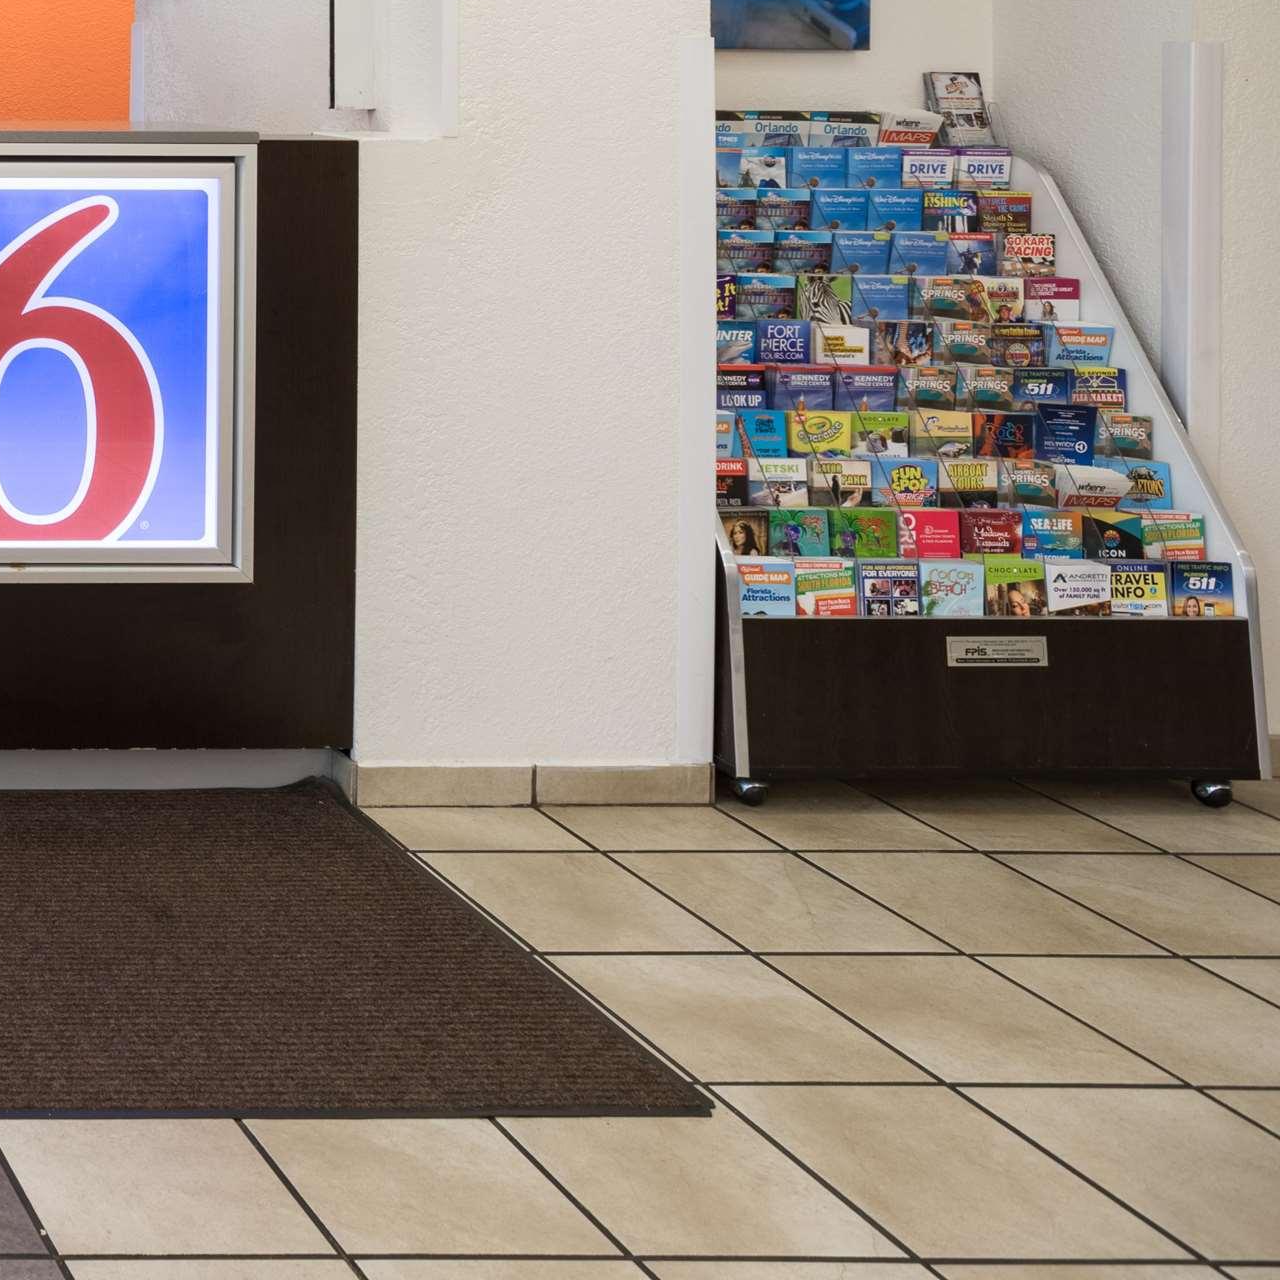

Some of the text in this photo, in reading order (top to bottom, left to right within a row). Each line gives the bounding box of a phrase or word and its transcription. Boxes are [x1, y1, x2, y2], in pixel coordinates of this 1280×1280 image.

[754, 122, 799, 134] Orlando
[823, 124, 867, 135] Orlando
[890, 132, 931, 143] MAPS
[910, 163, 947, 174] DRIVE
[968, 163, 1004, 174] DRIVE
[924, 196, 968, 208] FISHING
[1007, 236, 1052, 246] GO KART
[1006, 246, 1052, 257] RACING
[921, 289, 966, 301] SPRINGS
[767, 325, 800, 338] FORT
[761, 339, 804, 352] PIERCE
[940, 334, 986, 346] SPRINGS
[1086, 336, 1106, 344] MAP
[760, 352, 804, 360] TOURS.COM
[1056, 353, 1103, 362] Attractions
[906, 381, 951, 392] SPRINGS
[963, 381, 1008, 392] SPRINGS
[1027, 383, 1053, 395] 511
[721, 395, 762, 407] LOOK UP
[1091, 393, 1123, 403] MARKET
[1099, 427, 1145, 440] SPRINGS
[757, 464, 800, 473] JETSKI
[892, 467, 922, 480] FUN
[948, 463, 988, 477] AIRBOAT
[841, 475, 867, 486] PARK
[891, 478, 928, 493] SPOT
[953, 476, 985, 489] TOURS
[1001, 474, 1050, 487] SPRINGS
[1078, 483, 1106, 492] where
[1069, 496, 1117, 506] MAPS
[1031, 518, 1073, 531] SEA LIFE
[1098, 550, 1126, 558] ICON
[1111, 574, 1158, 585] TRAVEL
[1188, 576, 1216, 590] 511
[742, 592, 791, 601] Attractions
[1111, 587, 1145, 598] INFO
